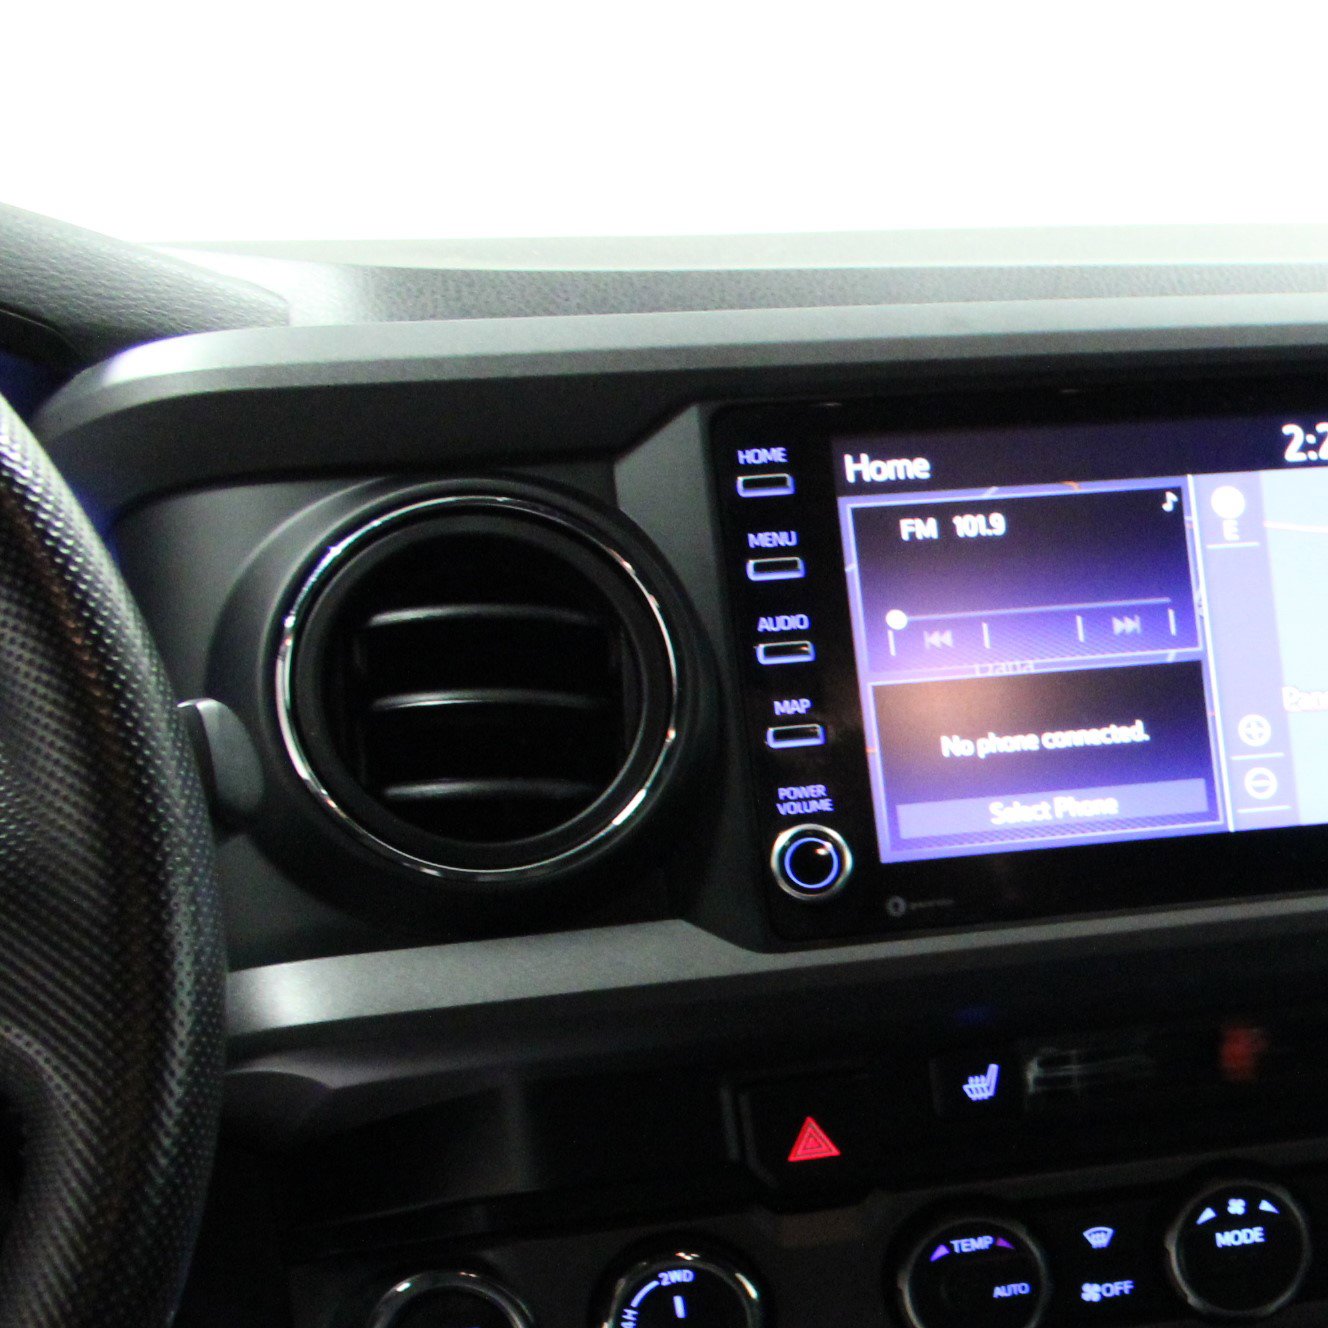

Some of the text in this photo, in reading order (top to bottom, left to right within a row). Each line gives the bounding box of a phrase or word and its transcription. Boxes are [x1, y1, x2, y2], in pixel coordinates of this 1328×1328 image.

[736, 446, 789, 465] HOME
[843, 452, 932, 484] Home
[899, 511, 1007, 542] FM 101.9
[747, 530, 799, 549] MENU
[756, 613, 812, 633] AUDIO
[773, 698, 813, 716] MAP
[939, 719, 1151, 760] No phone connected.
[777, 783, 828, 800] POWER
[776, 798, 834, 816] VOLUME
[988, 793, 1120, 826] Select Phone
[950, 1235, 994, 1254] TEMP
[1214, 1225, 1267, 1249] MODE
[657, 1268, 697, 1287] 2WD
[992, 1282, 1032, 1299] AUTO
[1099, 1279, 1135, 1298] OFF
